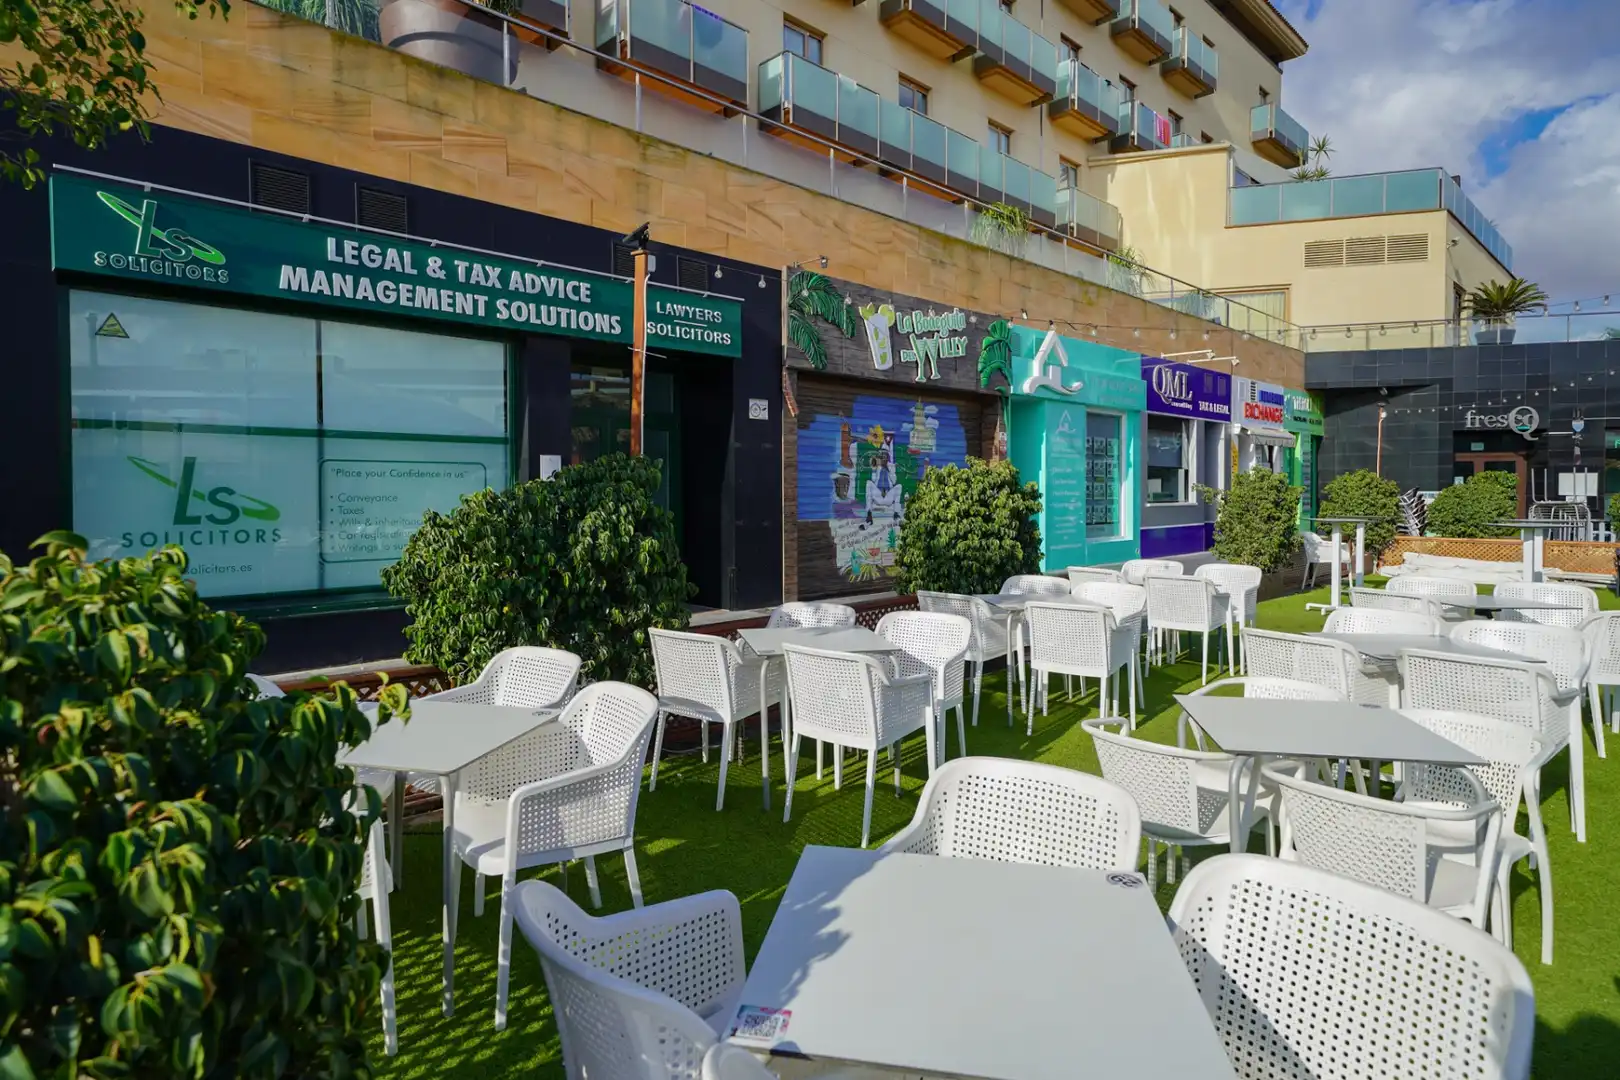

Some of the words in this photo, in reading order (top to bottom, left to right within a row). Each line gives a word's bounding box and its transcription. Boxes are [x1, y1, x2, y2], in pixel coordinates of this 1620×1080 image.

[94, 252, 229, 283] SOLICITORS
[327, 237, 417, 274] LEGAL
[426, 256, 446, 279] &
[454, 260, 502, 288] TAX
[509, 270, 591, 302] ADVICE
[279, 265, 488, 317] MANAGEMENT
[496, 299, 622, 335] SOLUTIONS
[656, 301, 722, 323] LAWYERS
[896, 311, 913, 334] La
[647, 322, 731, 345] SOLICITORS
[909, 332, 968, 382] WILLY
[1153, 365, 1193, 404] QML
[1244, 402, 1283, 424] EXCHANGE
[365, 470, 386, 480] your
[389, 469, 441, 478] Confidence
[443, 469, 452, 478] in
[337, 492, 398, 506] Conveyance
[337, 505, 365, 515] Taxes
[364, 517, 372, 526] &
[121, 528, 282, 548] SOLICITORS
[338, 531, 356, 541] Car
[338, 543, 377, 554] Writings
[185, 563, 253, 575] olicitors.es
